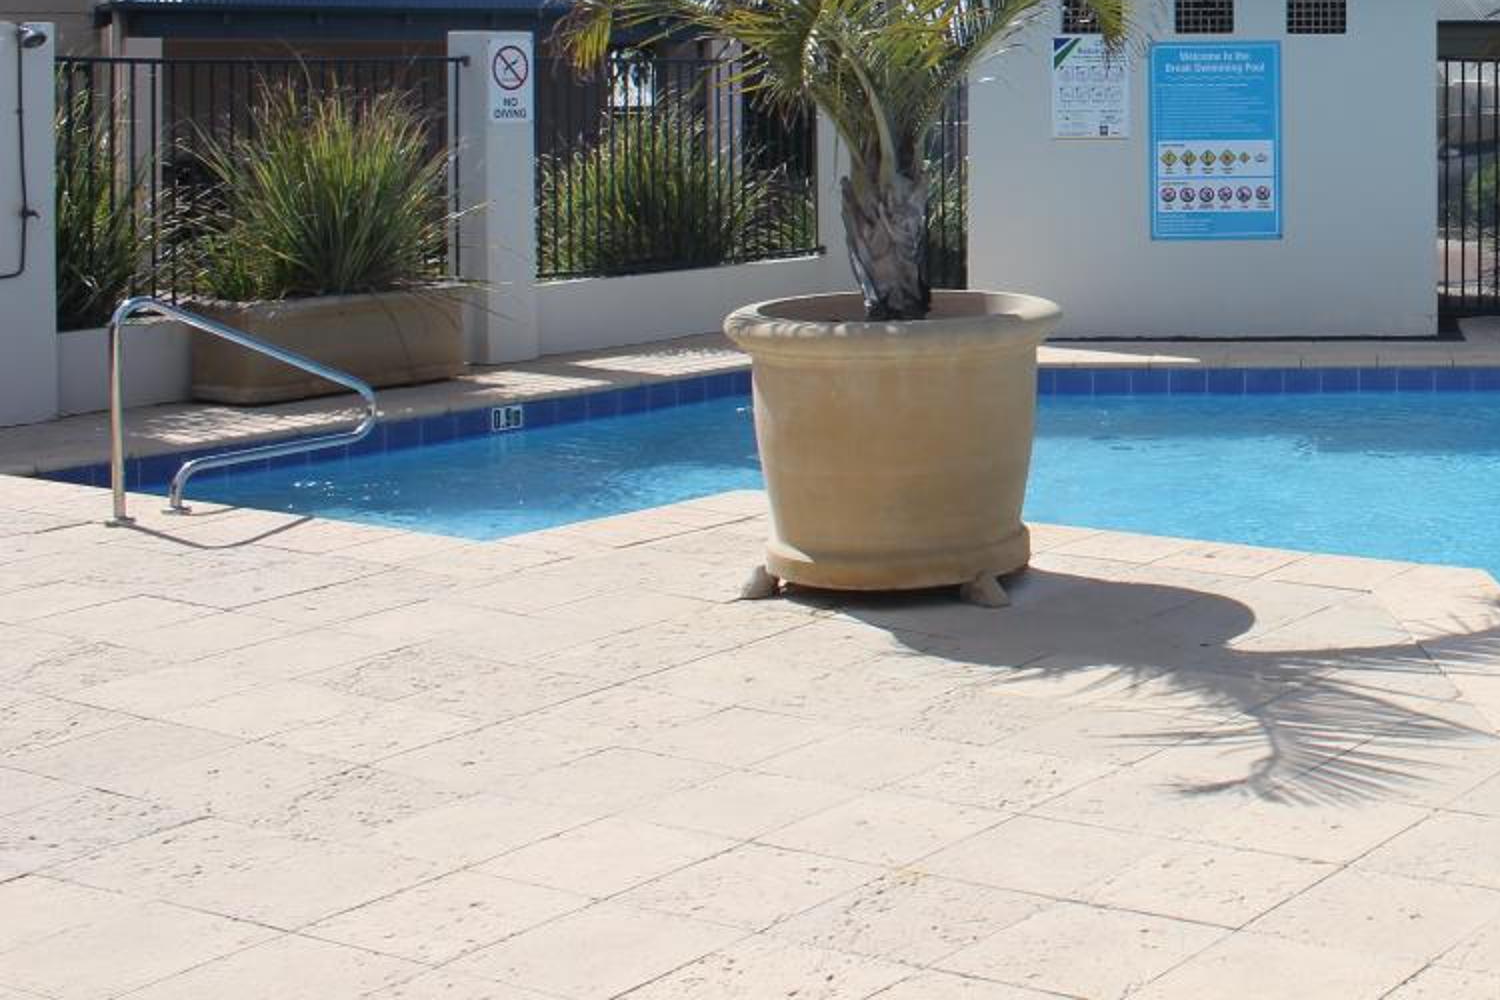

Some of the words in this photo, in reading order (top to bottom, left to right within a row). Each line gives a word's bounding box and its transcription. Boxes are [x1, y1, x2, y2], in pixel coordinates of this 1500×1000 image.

[1245, 61, 1265, 73] Pool
[503, 97, 519, 107] NO
[494, 108, 527, 119] DIVING
